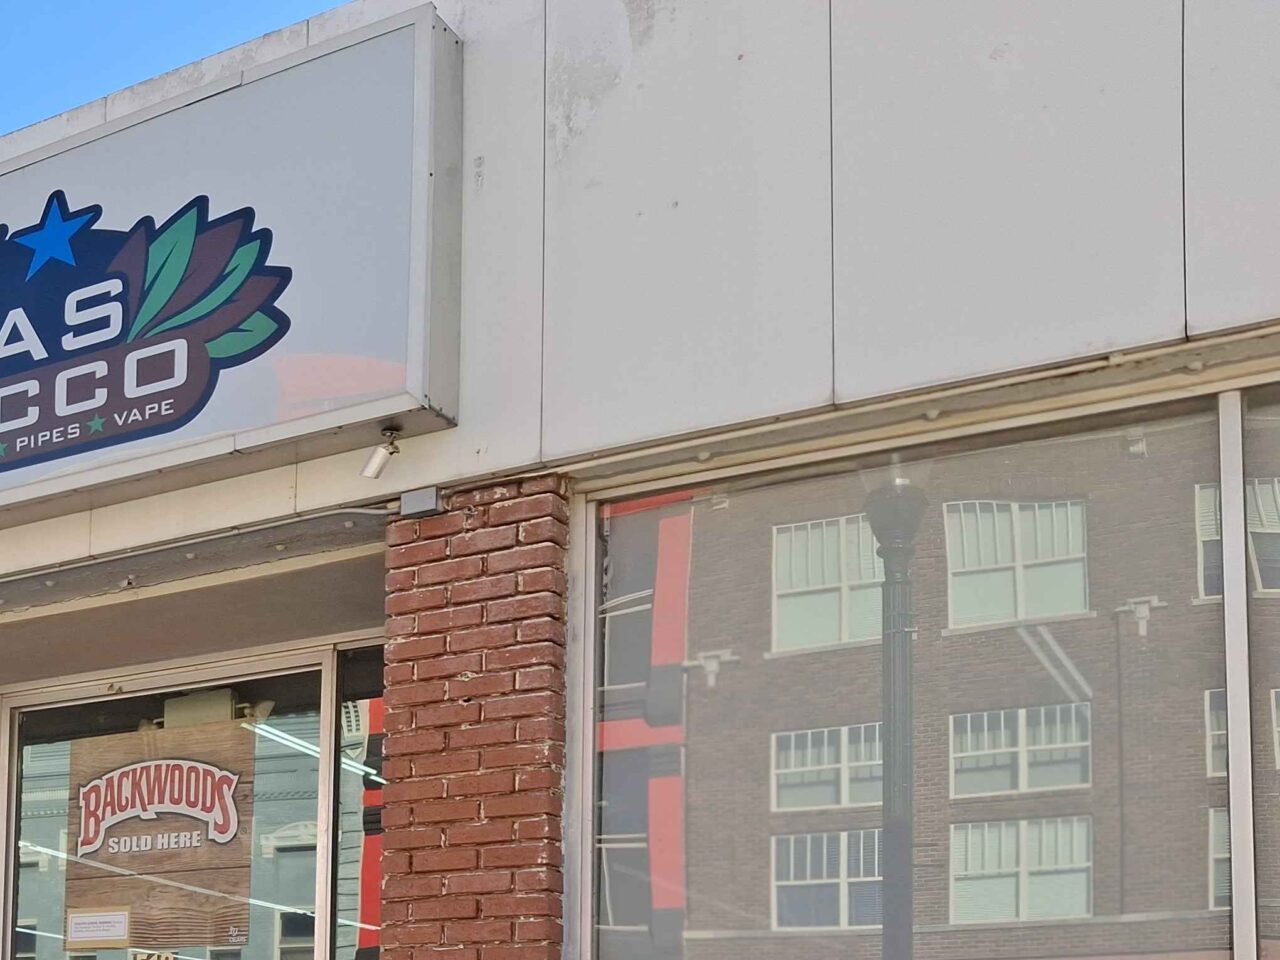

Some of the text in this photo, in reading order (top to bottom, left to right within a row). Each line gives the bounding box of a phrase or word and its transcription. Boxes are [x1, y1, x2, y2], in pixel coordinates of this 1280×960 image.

[16, 423, 81, 453] PIPES
[113, 399, 175, 426] VAPE
[79, 761, 239, 854] BACKWOODS
[108, 831, 202, 853] SOLD HERE
